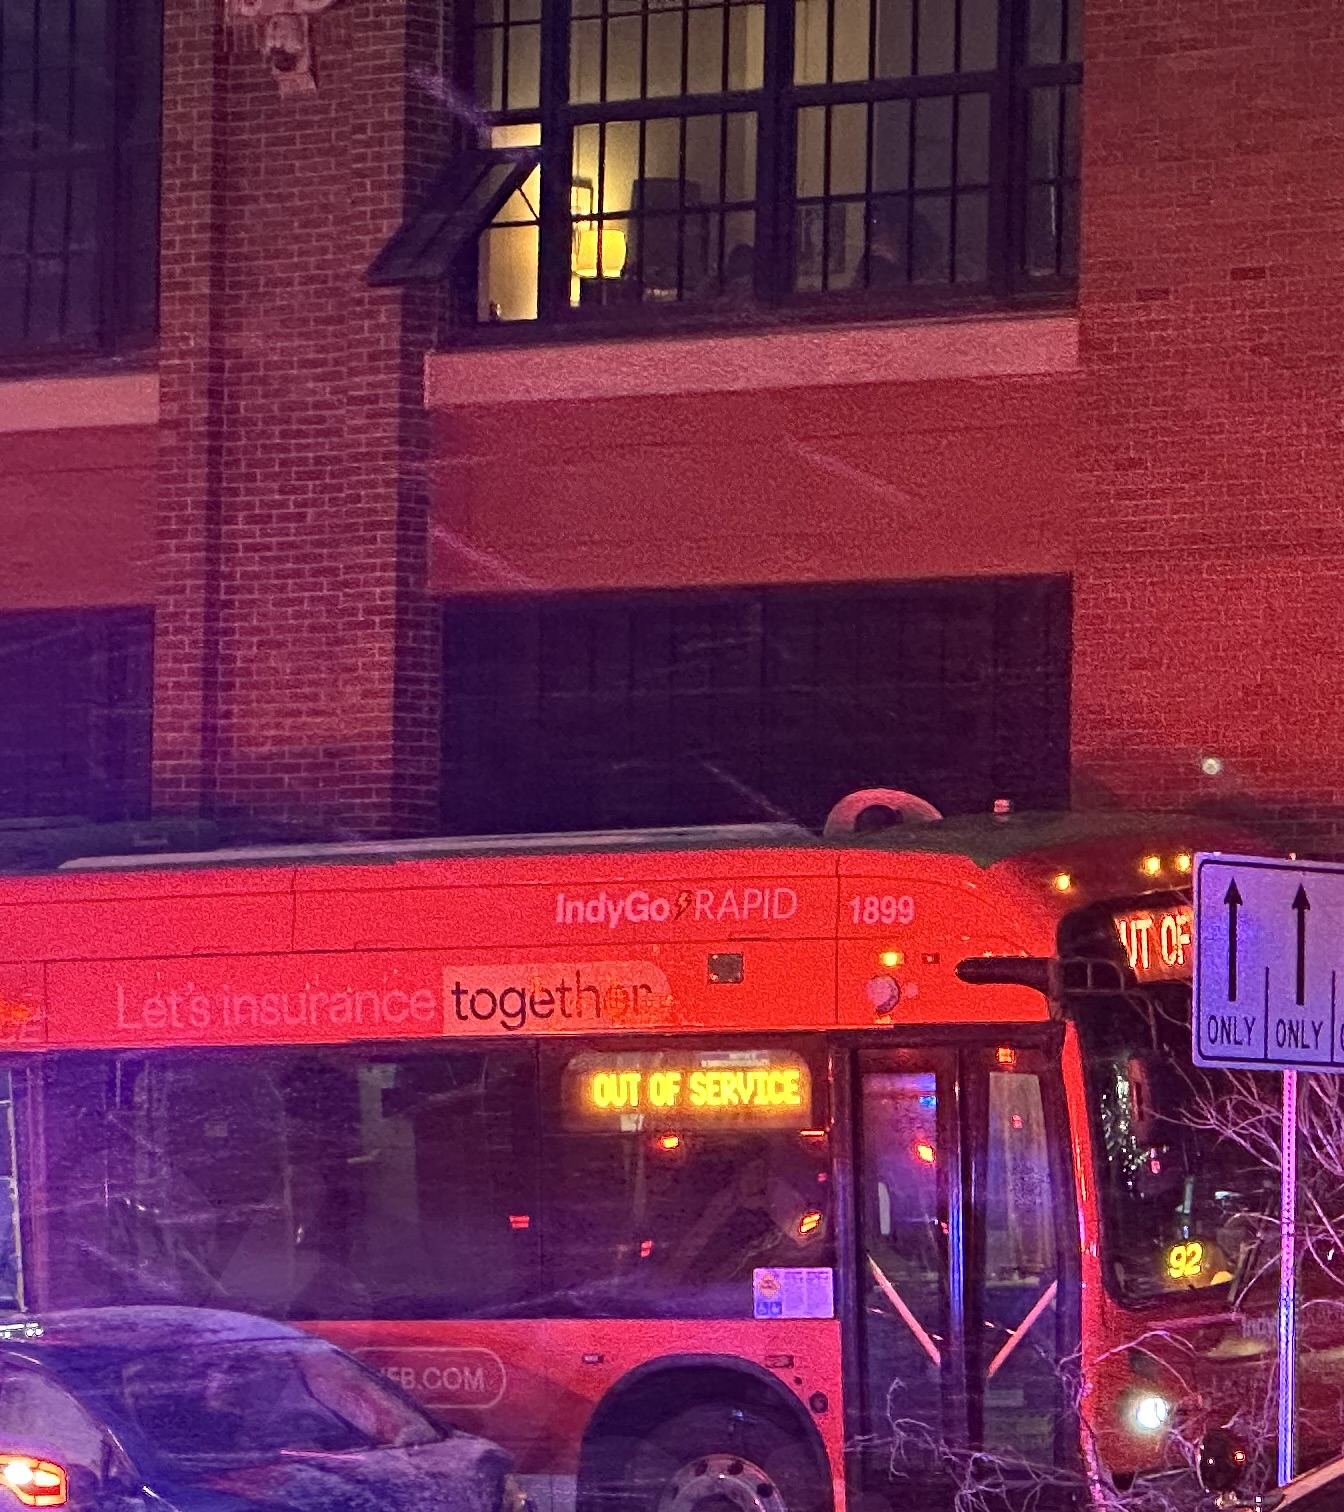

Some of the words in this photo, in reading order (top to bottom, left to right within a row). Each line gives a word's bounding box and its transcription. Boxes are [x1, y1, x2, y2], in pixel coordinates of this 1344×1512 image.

[556, 890, 670, 929] IndyGo
[694, 887, 798, 921] RAPID
[850, 895, 915, 925] 1899
[1116, 916, 1153, 970] UT
[115, 980, 212, 1029] Let's
[223, 981, 436, 1028] insurance
[450, 969, 654, 1030] together
[1207, 1014, 1256, 1047] ONLY
[1275, 1018, 1324, 1050] ONLY
[592, 1072, 642, 1108] OUT
[649, 1071, 682, 1107] OF
[689, 1070, 801, 1106] SERVICE
